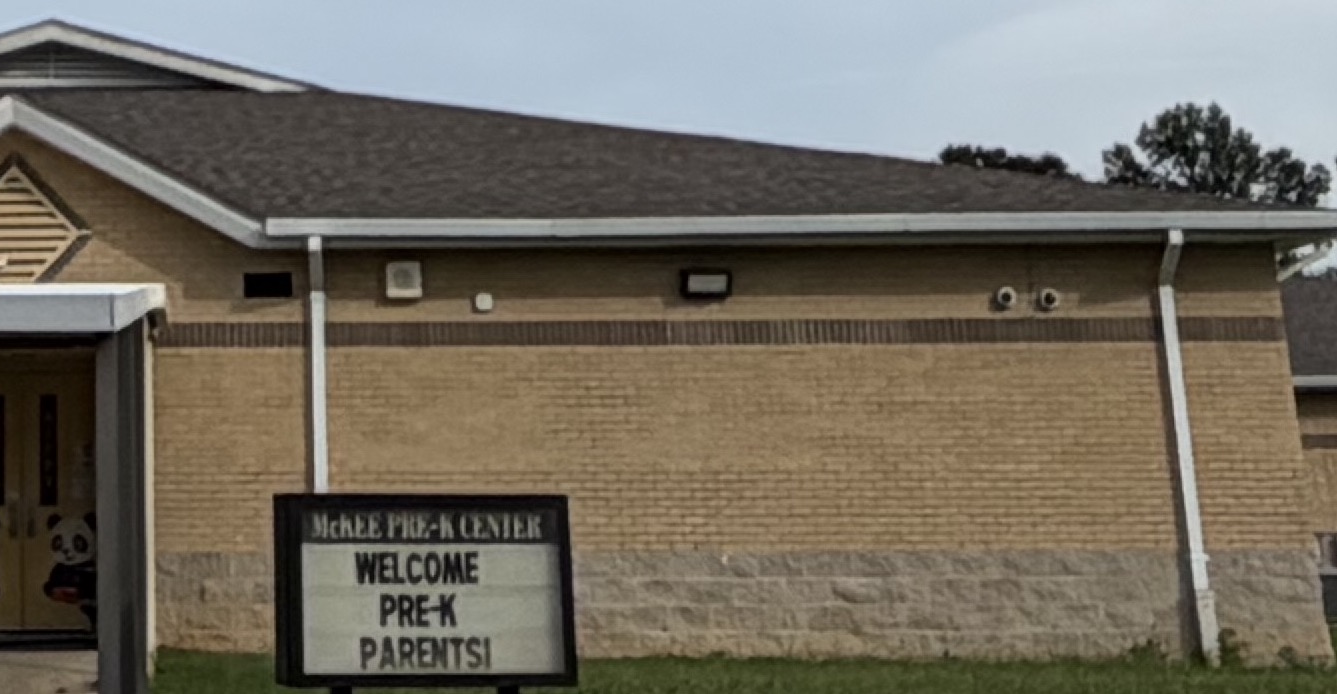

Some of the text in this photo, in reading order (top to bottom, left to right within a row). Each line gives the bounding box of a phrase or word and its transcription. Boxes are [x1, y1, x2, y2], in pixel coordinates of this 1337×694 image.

[312, 512, 543, 539] McKEE PRE-K CENTER
[355, 551, 479, 585] WELCOME
[379, 593, 457, 627] PRE-K
